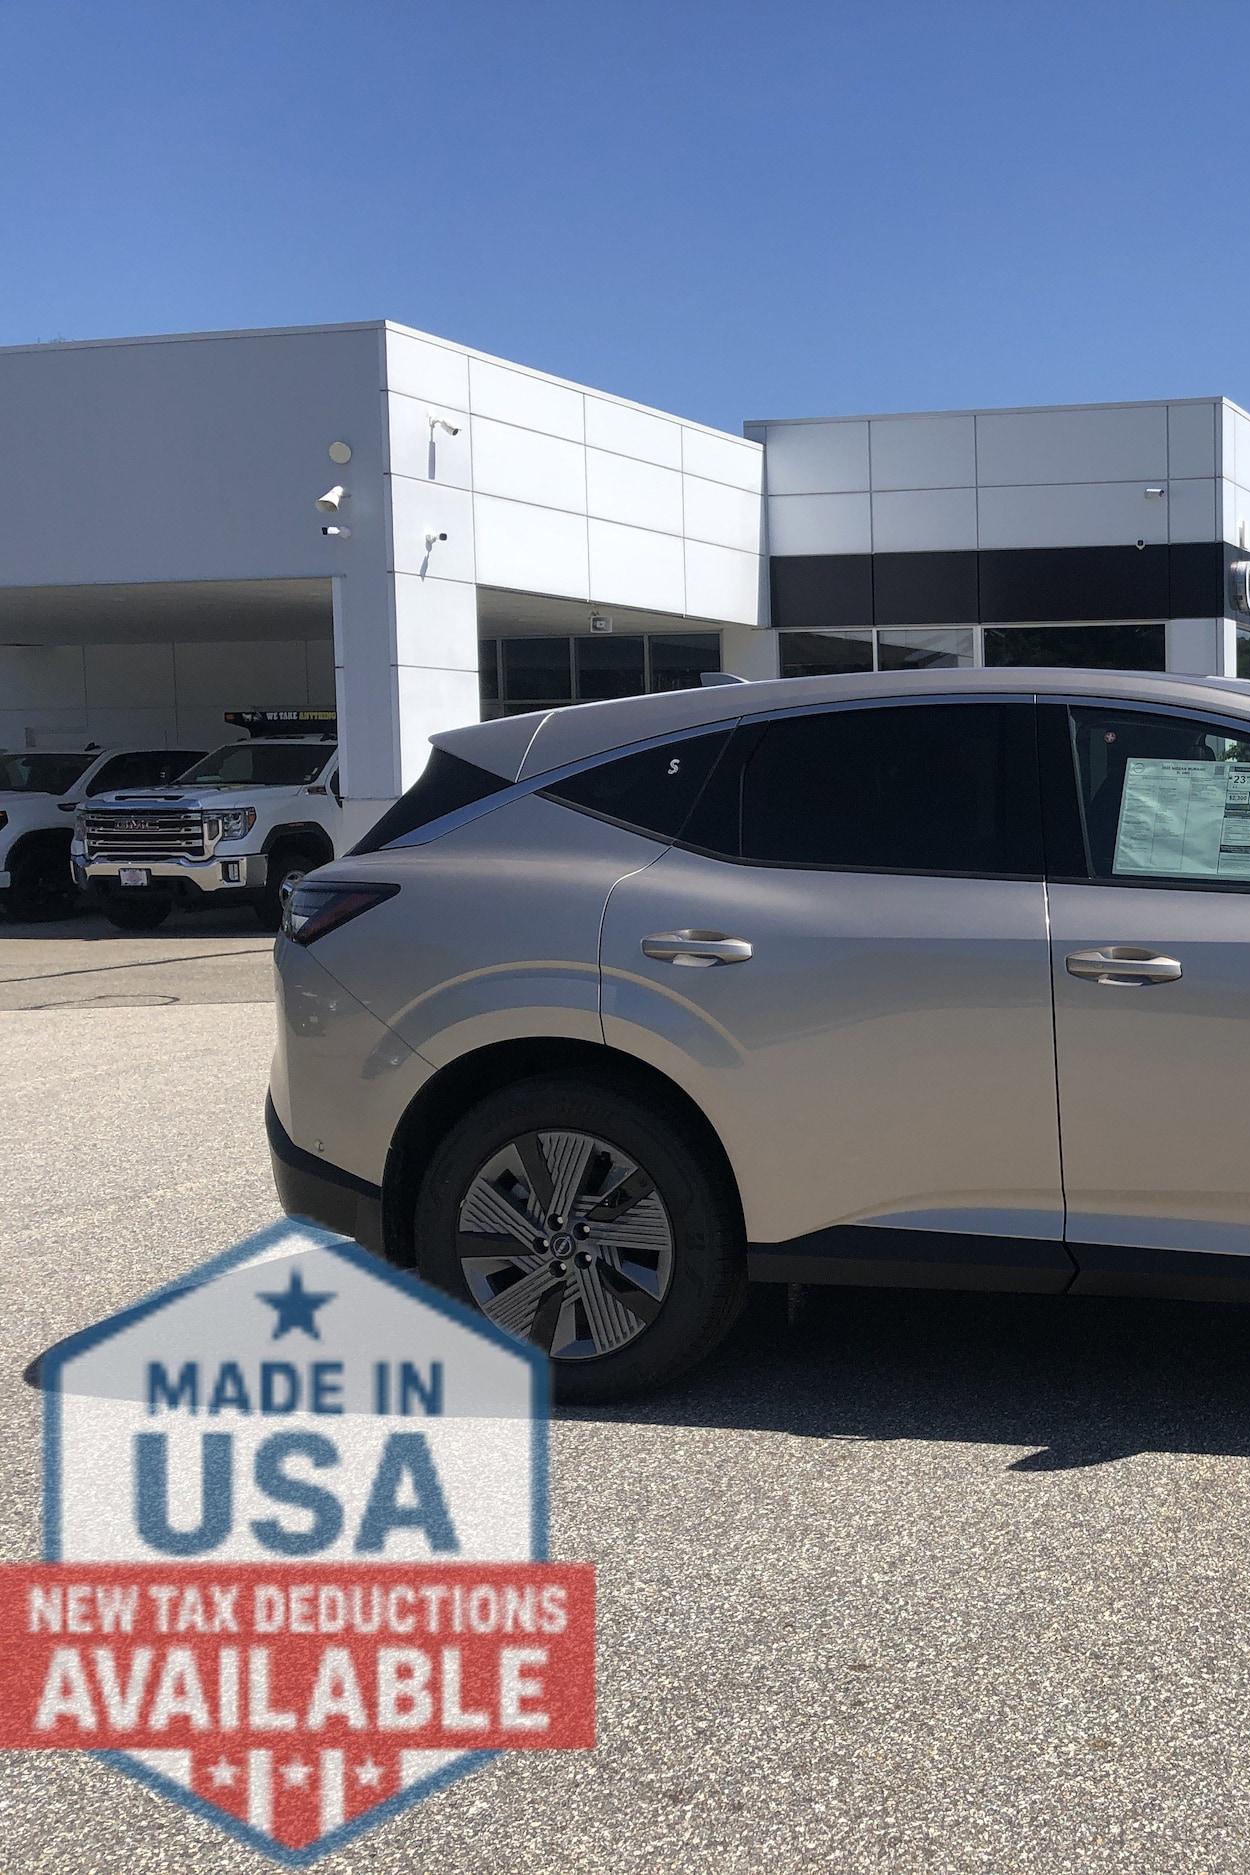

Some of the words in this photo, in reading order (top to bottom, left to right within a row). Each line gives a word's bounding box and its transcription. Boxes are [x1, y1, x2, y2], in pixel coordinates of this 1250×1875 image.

[266, 712, 278, 720] WE
[279, 712, 298, 720] TAKE
[667, 759, 680, 775] S
[1233, 775, 1246, 784] 23
[114, 818, 160, 831] GMC
